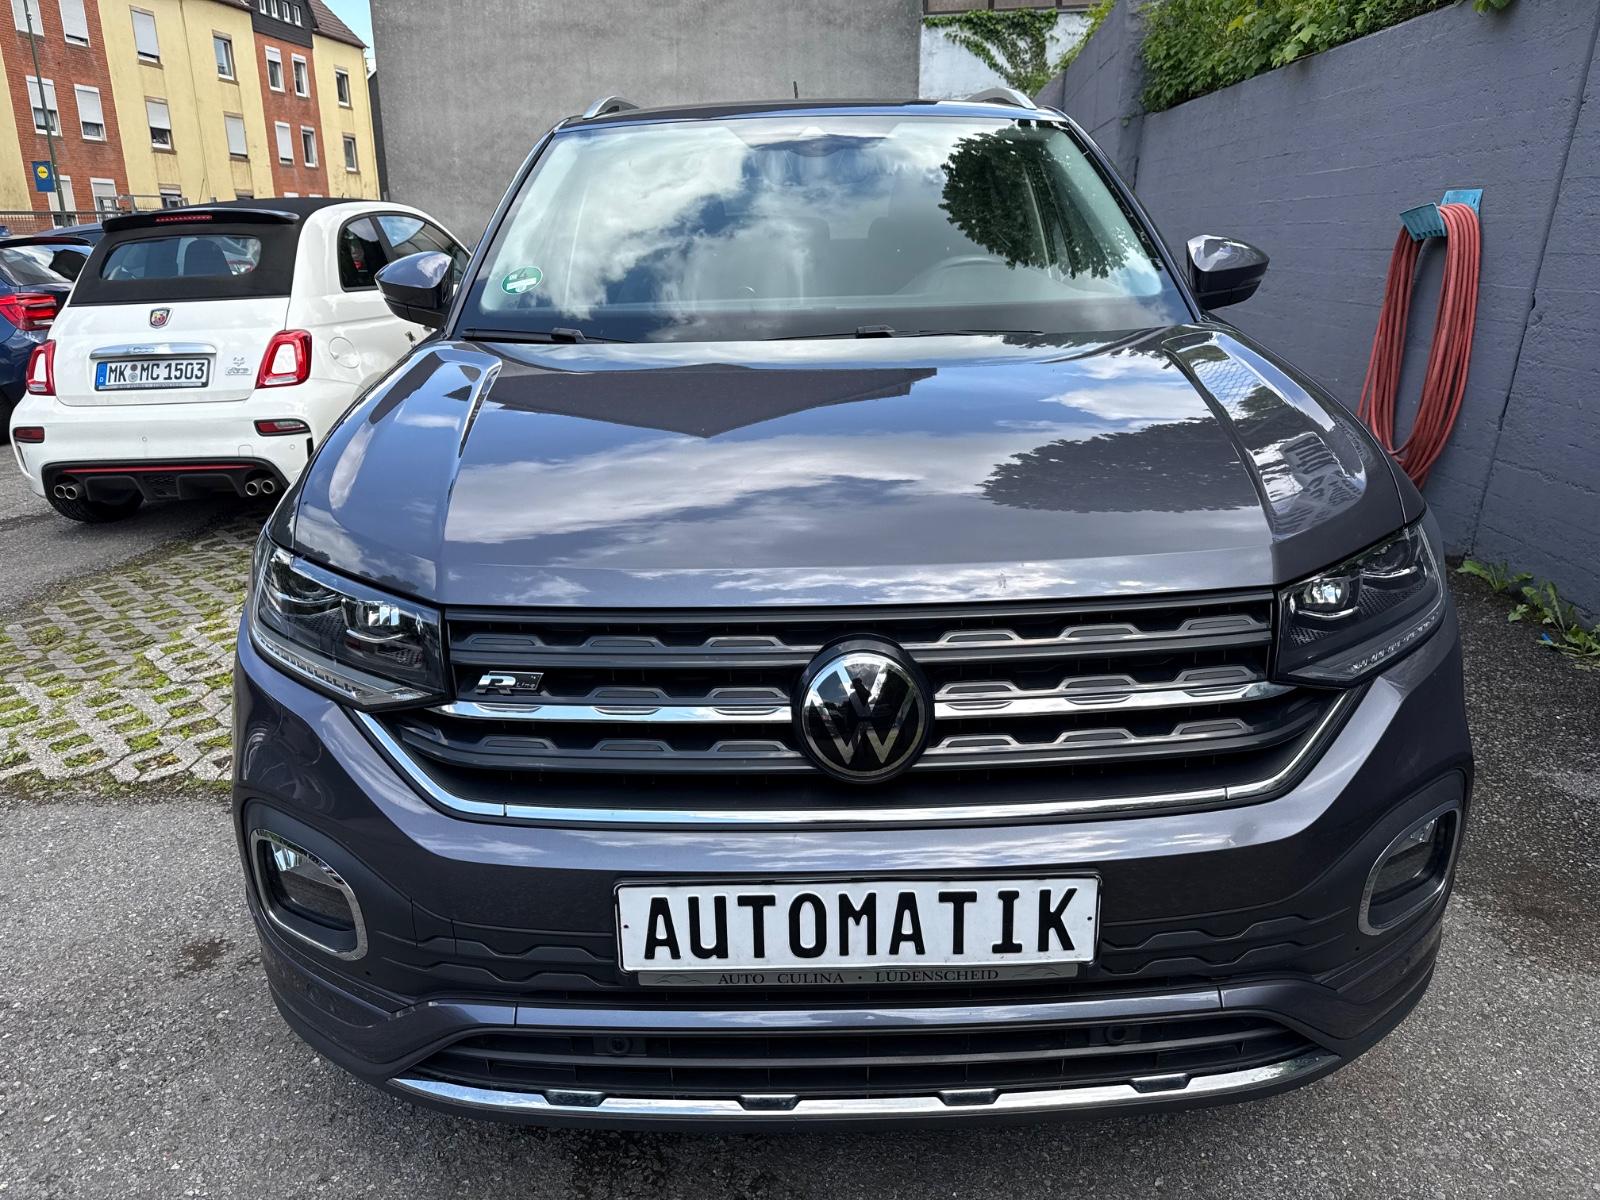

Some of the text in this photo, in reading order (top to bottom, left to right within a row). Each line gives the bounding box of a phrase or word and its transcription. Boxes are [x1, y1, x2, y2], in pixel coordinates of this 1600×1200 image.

[107, 364, 128, 383] MK
[139, 363, 160, 382] MC
[163, 362, 205, 381] 1503
[644, 888, 1079, 959] AUTOMATIK
[718, 973, 765, 985] AUTO
[777, 972, 844, 984] CULINA
